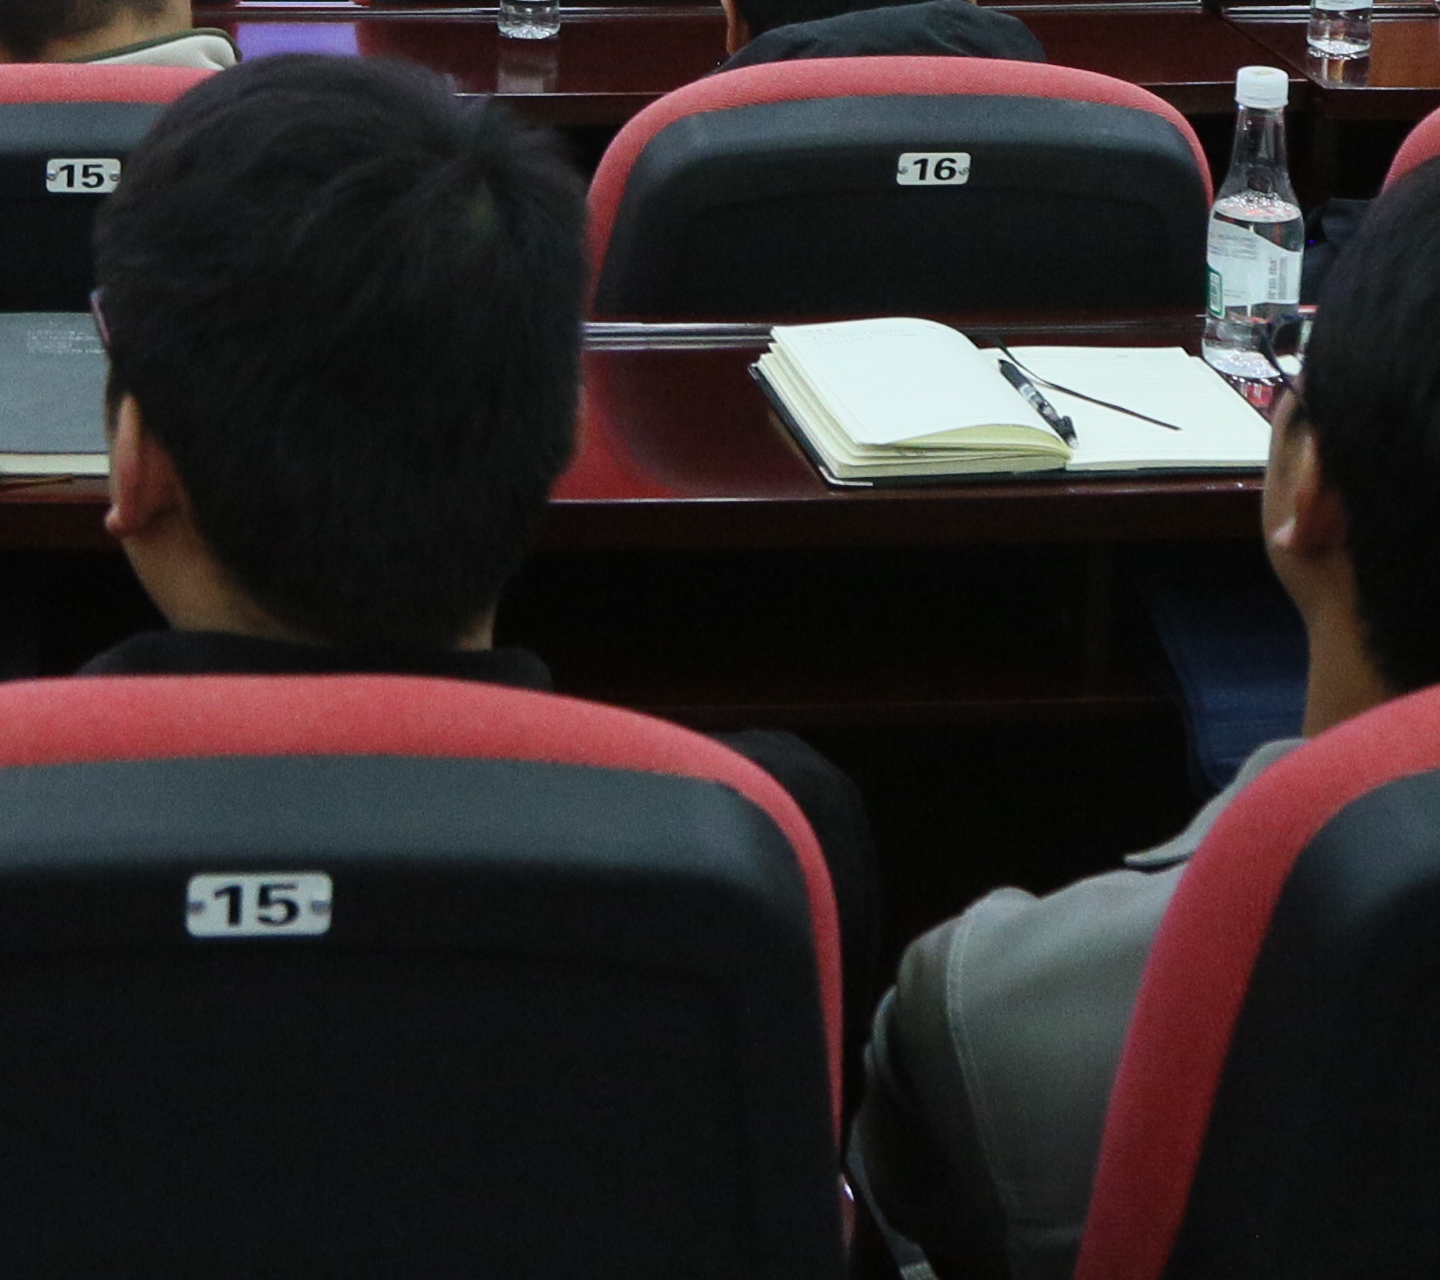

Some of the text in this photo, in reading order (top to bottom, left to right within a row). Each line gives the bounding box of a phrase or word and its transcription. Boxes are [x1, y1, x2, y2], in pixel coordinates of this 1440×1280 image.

[58, 164, 104, 188] 15
[912, 157, 957, 180] 16
[213, 884, 298, 928] 15
